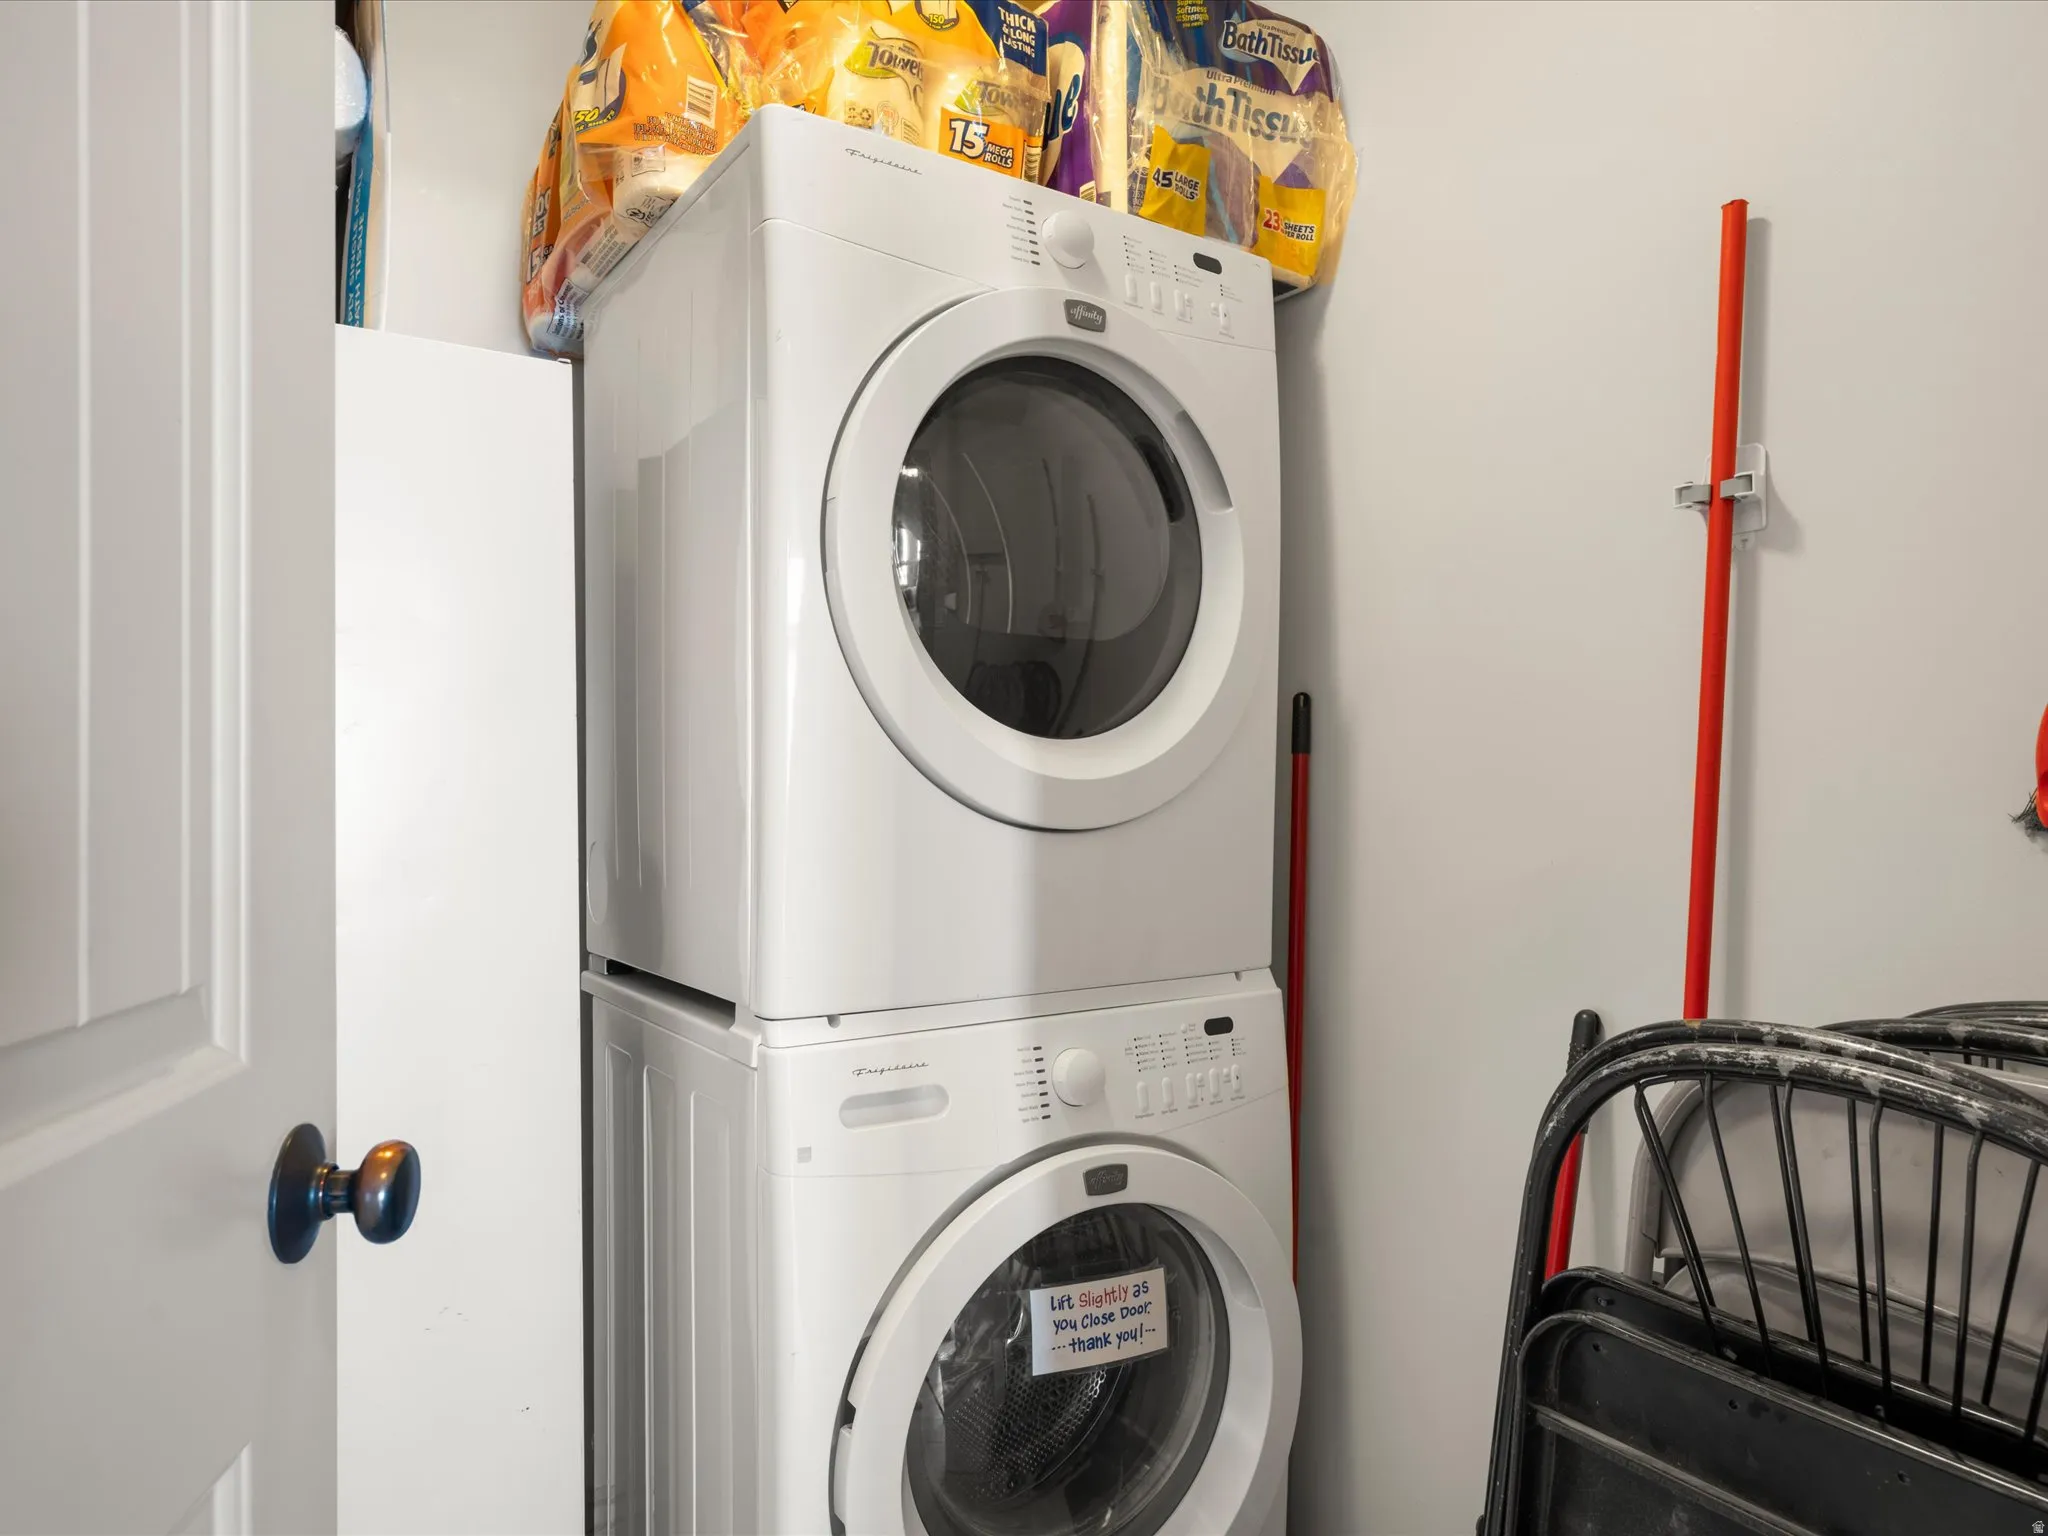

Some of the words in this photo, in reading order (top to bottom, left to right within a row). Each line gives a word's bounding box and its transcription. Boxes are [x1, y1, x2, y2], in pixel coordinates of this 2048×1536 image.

[929, 14, 945, 24] 150
[997, 6, 1037, 33] THICK
[1177, 6, 1208, 15] Softness
[1182, 13, 1210, 22] Strength
[1002, 23, 1009, 35] &
[1010, 28, 1036, 47] LONG
[1256, 21, 1271, 30] Ultra
[1271, 25, 1297, 37] Premium
[1002, 34, 1036, 58] LASTING
[1206, 70, 1233, 84] Ultra
[1233, 76, 1277, 96] Premium
[949, 118, 989, 159] 15
[986, 143, 1013, 158] MEGA
[845, 148, 923, 176] Frigidaire
[984, 152, 1013, 168] ROLLS
[1152, 168, 1174, 188] 45
[1174, 171, 1200, 191] LARGE
[1283, 222, 1315, 234] SHEETS
[1284, 231, 1295, 239] PER
[1295, 233, 1314, 241] ROLL
[349, 218, 359, 286] SINGLE
[355, 211, 365, 281] TISSUE
[1070, 304, 1103, 325] affinity
[851, 1061, 929, 1077] Frigidaire
[1078, 1284, 1129, 1308] Slightly
[1132, 1280, 1149, 1298] as
[1053, 1318, 1078, 1336] you
[1081, 1312, 1116, 1329] Close
[1120, 1300, 1153, 1320] Door.
